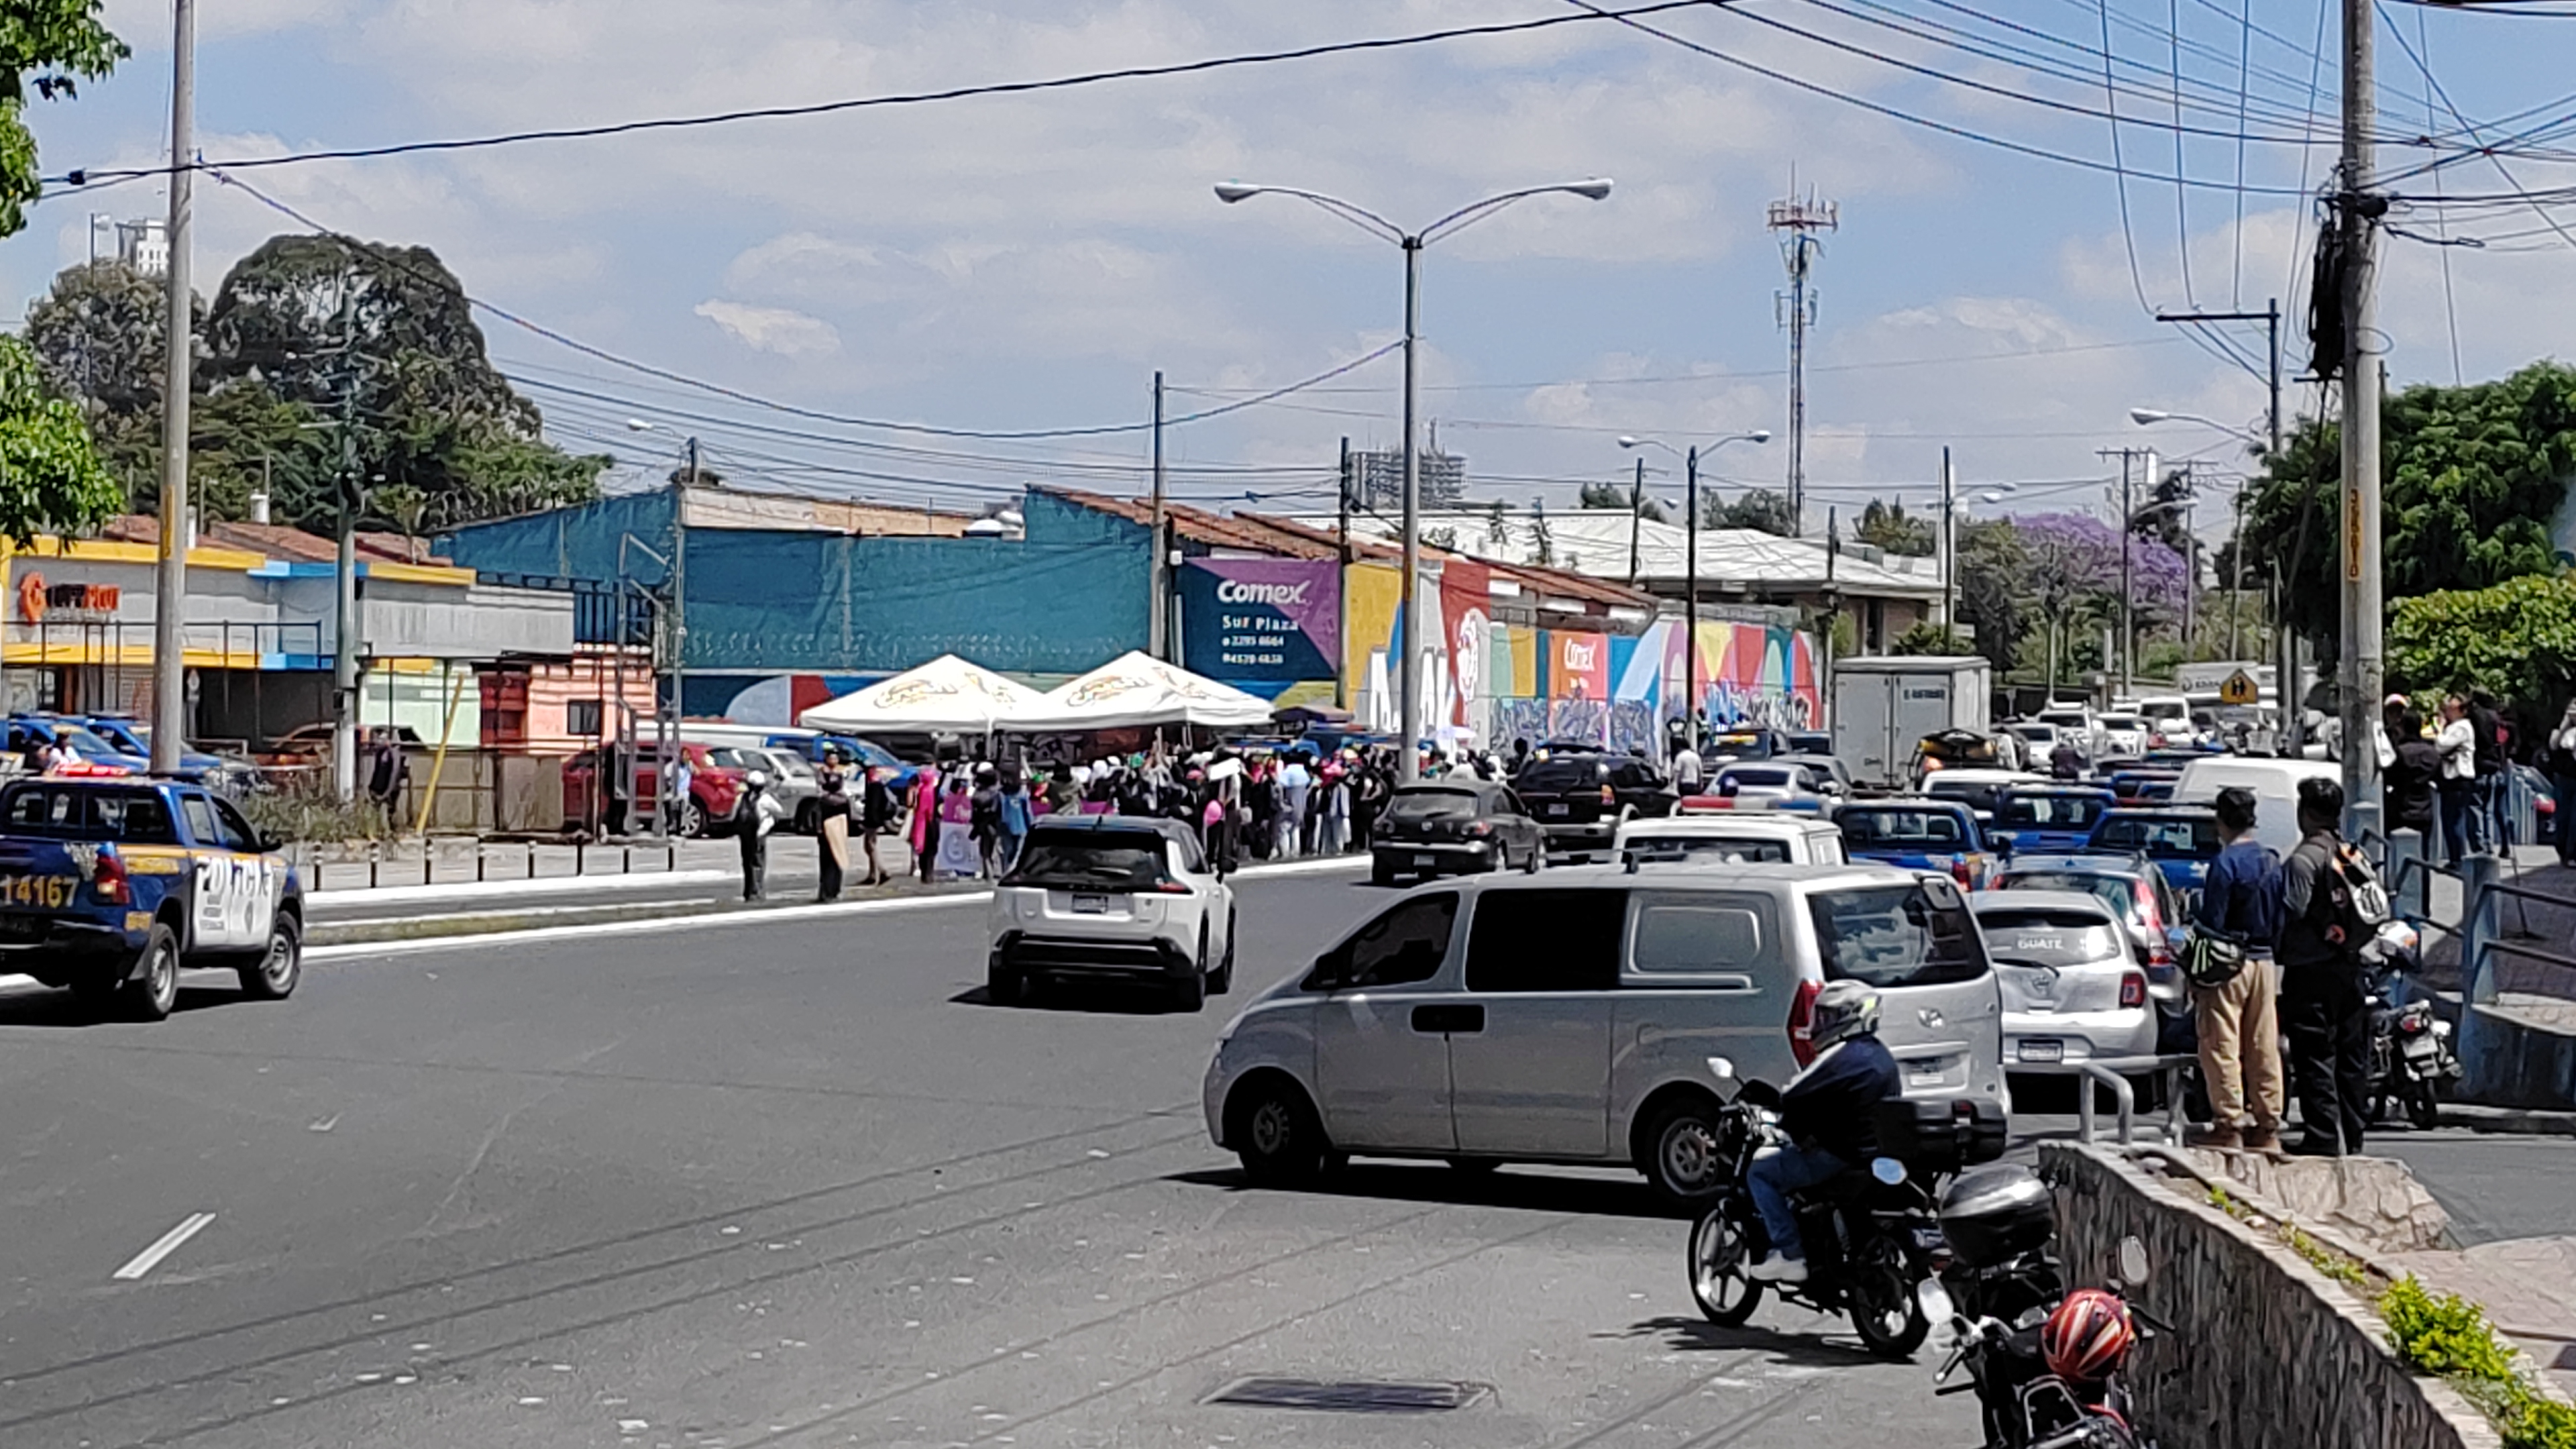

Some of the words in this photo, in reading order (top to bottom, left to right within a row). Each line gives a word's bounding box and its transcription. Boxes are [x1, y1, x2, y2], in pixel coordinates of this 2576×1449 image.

[1217, 580, 1311, 604] Comex
[1222, 615, 1250, 630] Sur
[1256, 616, 1299, 631] Plaza
[2017, 937, 2063, 950] GUATE
